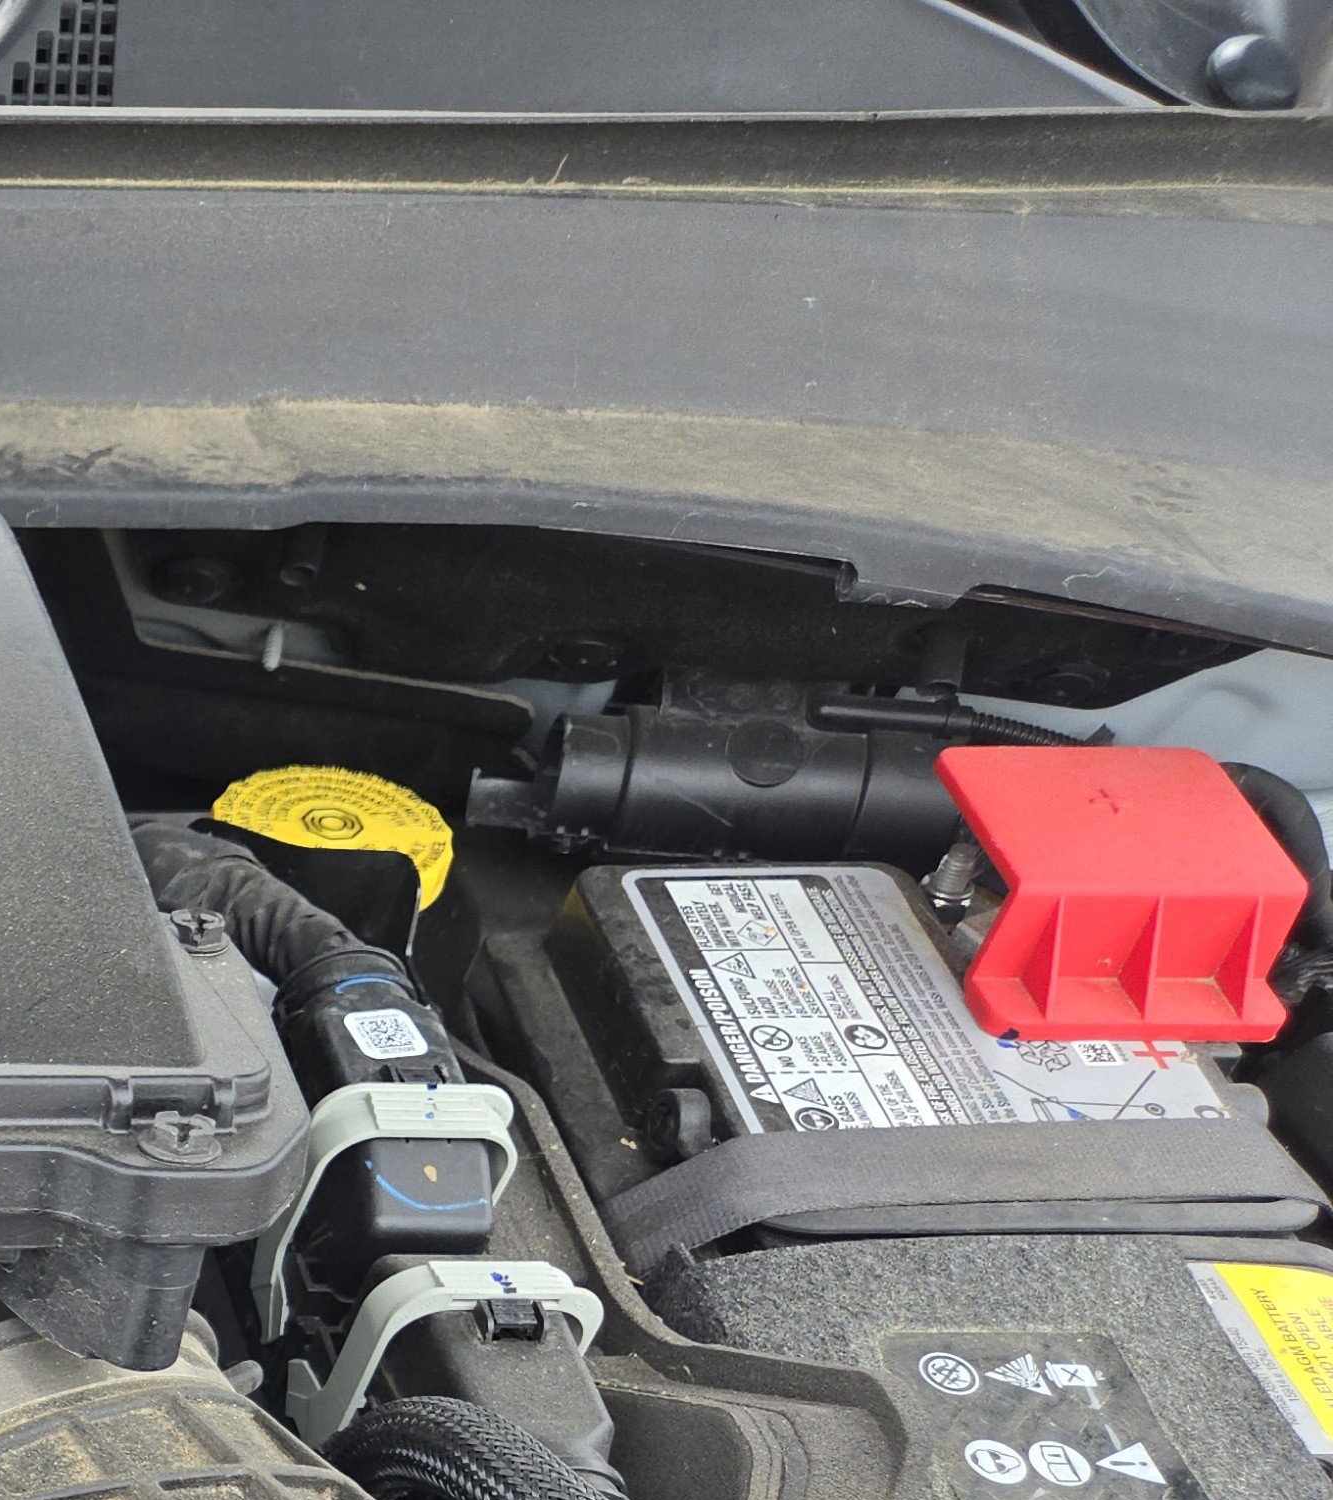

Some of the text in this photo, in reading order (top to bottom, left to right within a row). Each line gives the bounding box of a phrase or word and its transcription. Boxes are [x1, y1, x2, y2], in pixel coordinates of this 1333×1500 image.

[686, 968, 767, 1082] DANGER/POISON
[775, 1055, 796, 1067] NO
[826, 1095, 855, 1122] GASES
[1249, 1287, 1298, 1341] BATTERY
[1284, 1311, 1323, 1349] OPEN!
[1288, 1345, 1319, 1374] AGM
